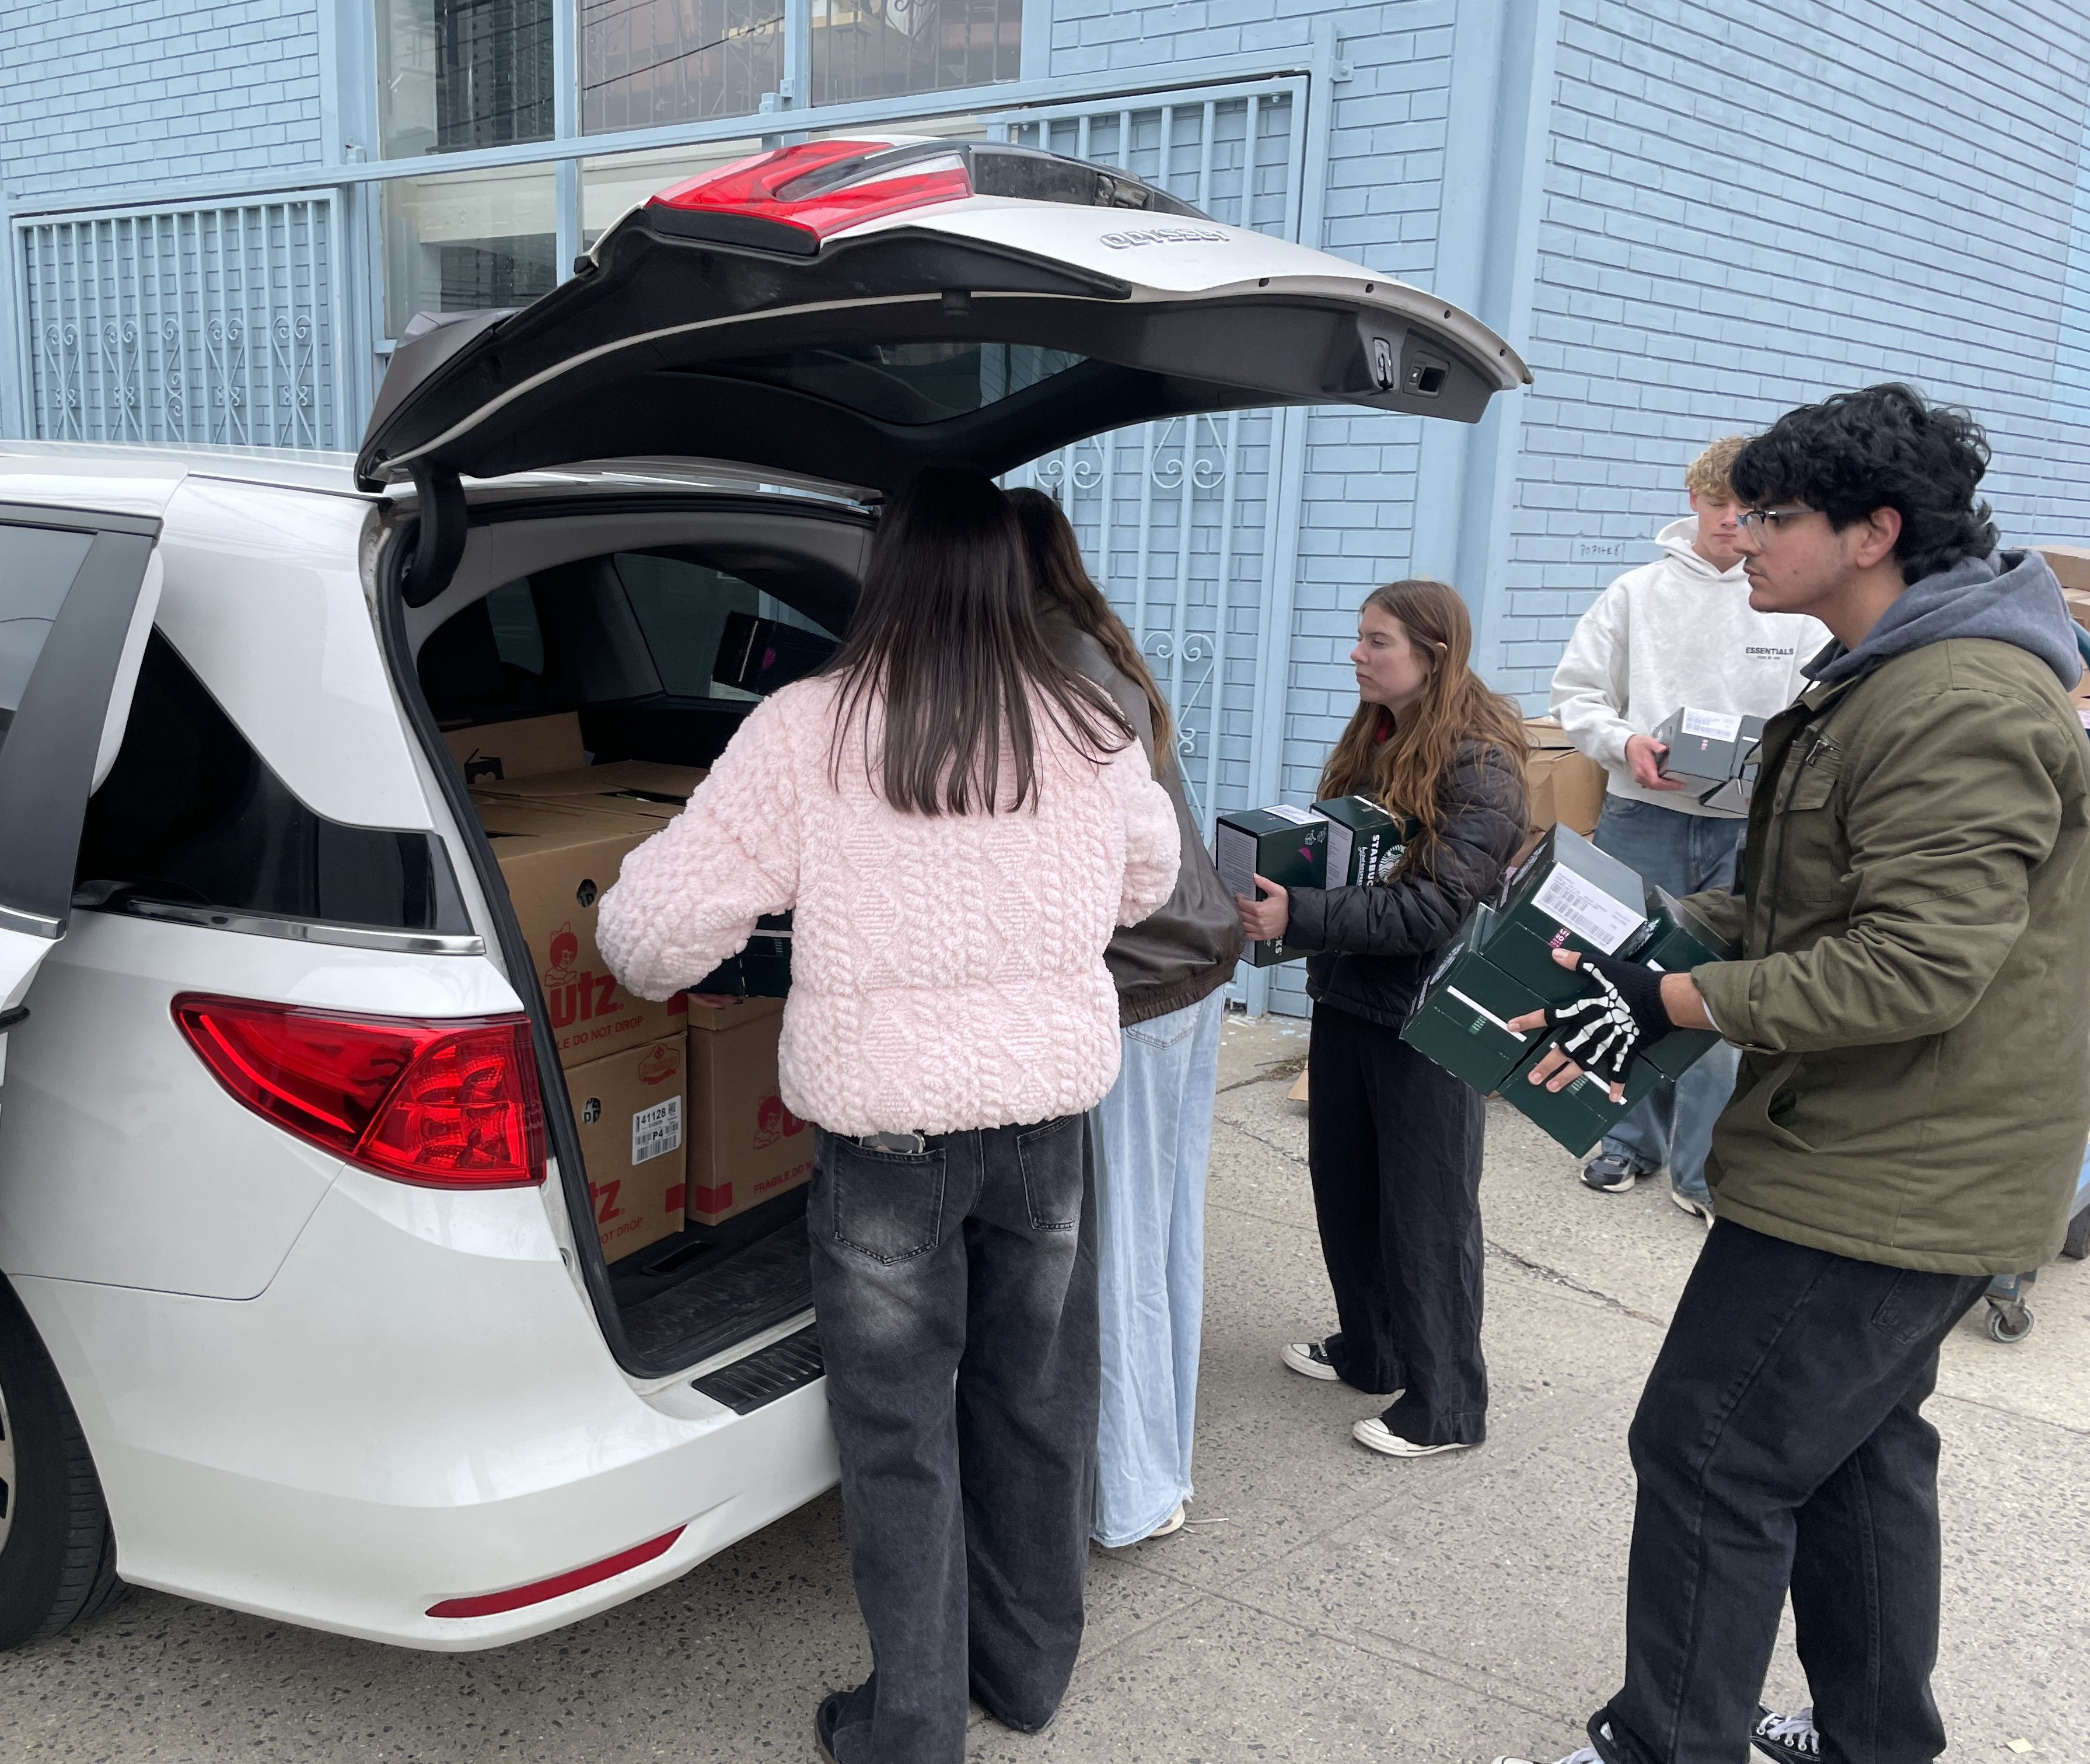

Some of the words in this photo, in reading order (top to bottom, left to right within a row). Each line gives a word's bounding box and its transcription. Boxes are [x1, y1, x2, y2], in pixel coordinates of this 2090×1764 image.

[1746, 647, 1794, 655] ESSENTIALS
[1366, 834, 1380, 887] STARBUC
[573, 1032, 588, 1046] DO
[591, 1024, 613, 1041] NOT
[615, 1016, 644, 1033] DROP
[754, 1170, 791, 1195] FRAGILE
[602, 1230, 614, 1244] OT
[617, 1217, 643, 1237] DROP
